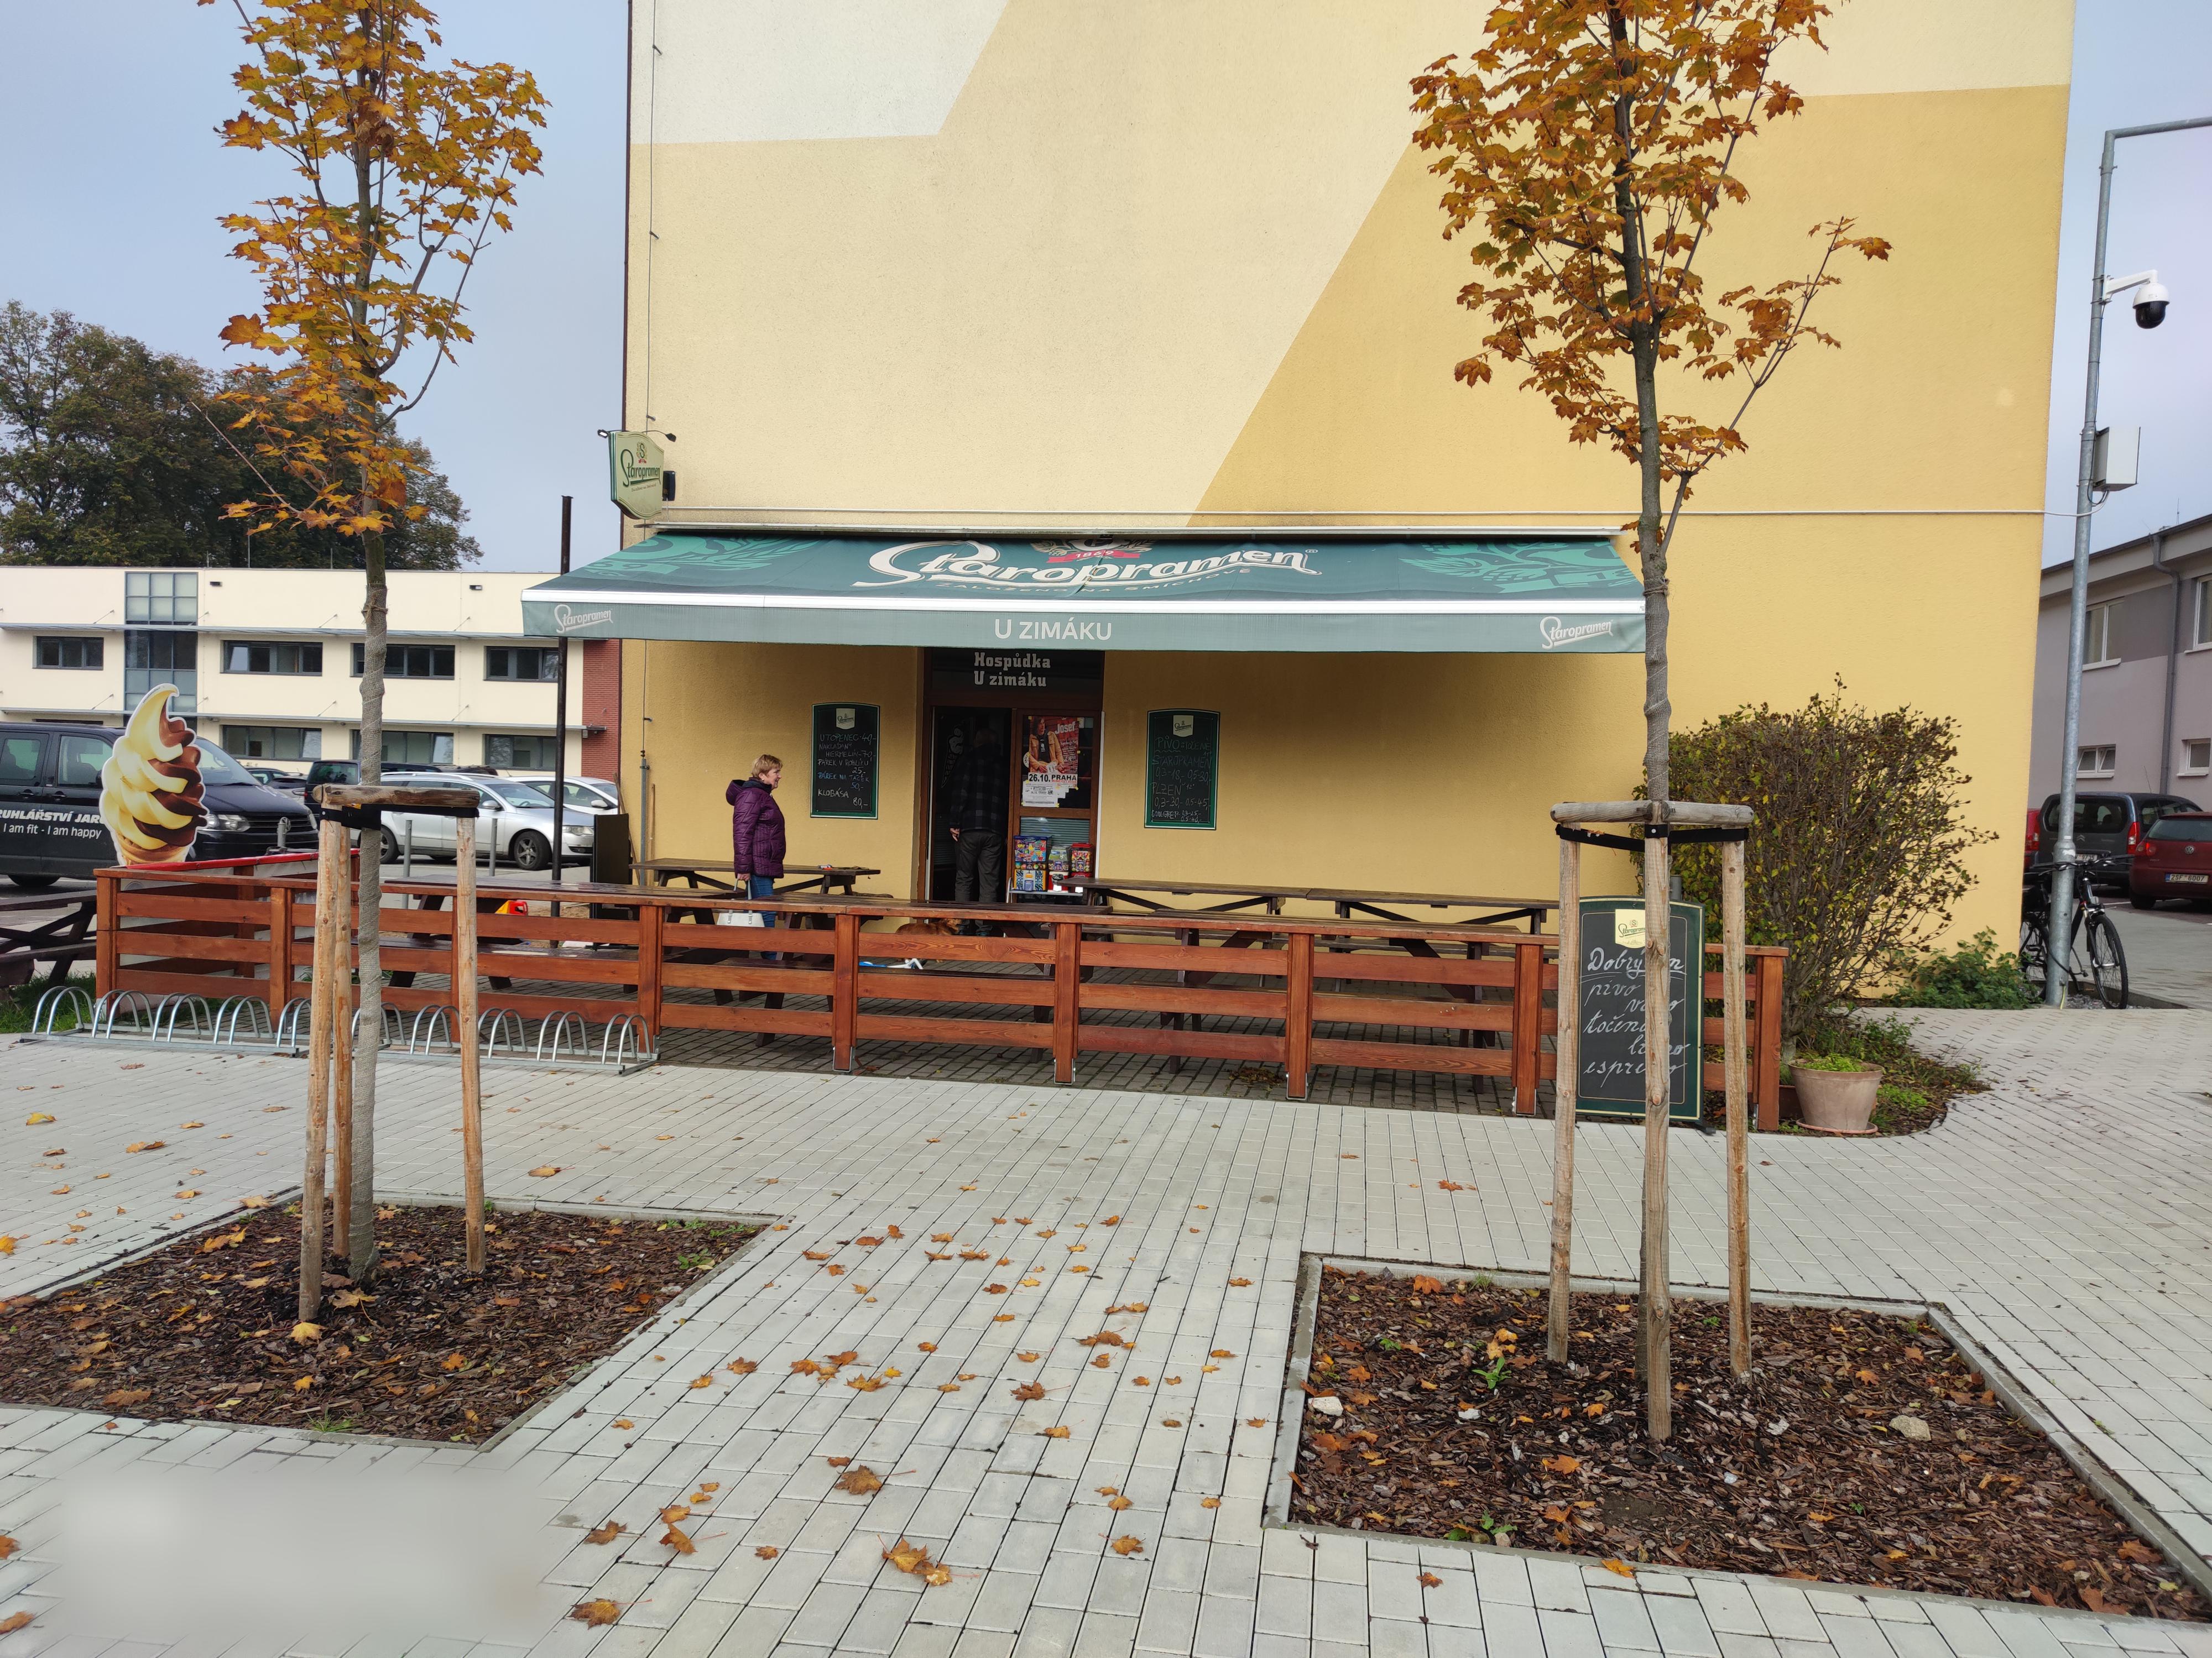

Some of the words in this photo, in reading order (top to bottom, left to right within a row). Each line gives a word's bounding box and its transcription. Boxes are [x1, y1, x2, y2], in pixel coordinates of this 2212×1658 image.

[620, 449, 661, 487] Staropramen
[850, 540, 1323, 587] Staropramen
[937, 583, 1068, 592] ZALOŽENO
[554, 604, 613, 633] Staropramen
[995, 619, 1012, 639] U
[1019, 617, 1112, 640] ZIMÁKU
[1540, 616, 1614, 650] Staropramen
[974, 652, 1051, 671] Hospůdka
[974, 671, 985, 685] U
[989, 672, 1046, 687] zimáku
[1055, 721, 1076, 735] Josef
[1029, 773, 1051, 782] 26.10.
[818, 788, 849, 798] KLOBÁSA
[75, 814, 102, 824] JAR
[3, 823, 7, 833] I
[9, 825, 24, 834] am
[27, 824, 39, 834] fit
[48, 825, 51, 835] I
[53, 828, 68, 836] am
[71, 827, 102, 839] happy
[1588, 947, 1645, 979] Dobrý
